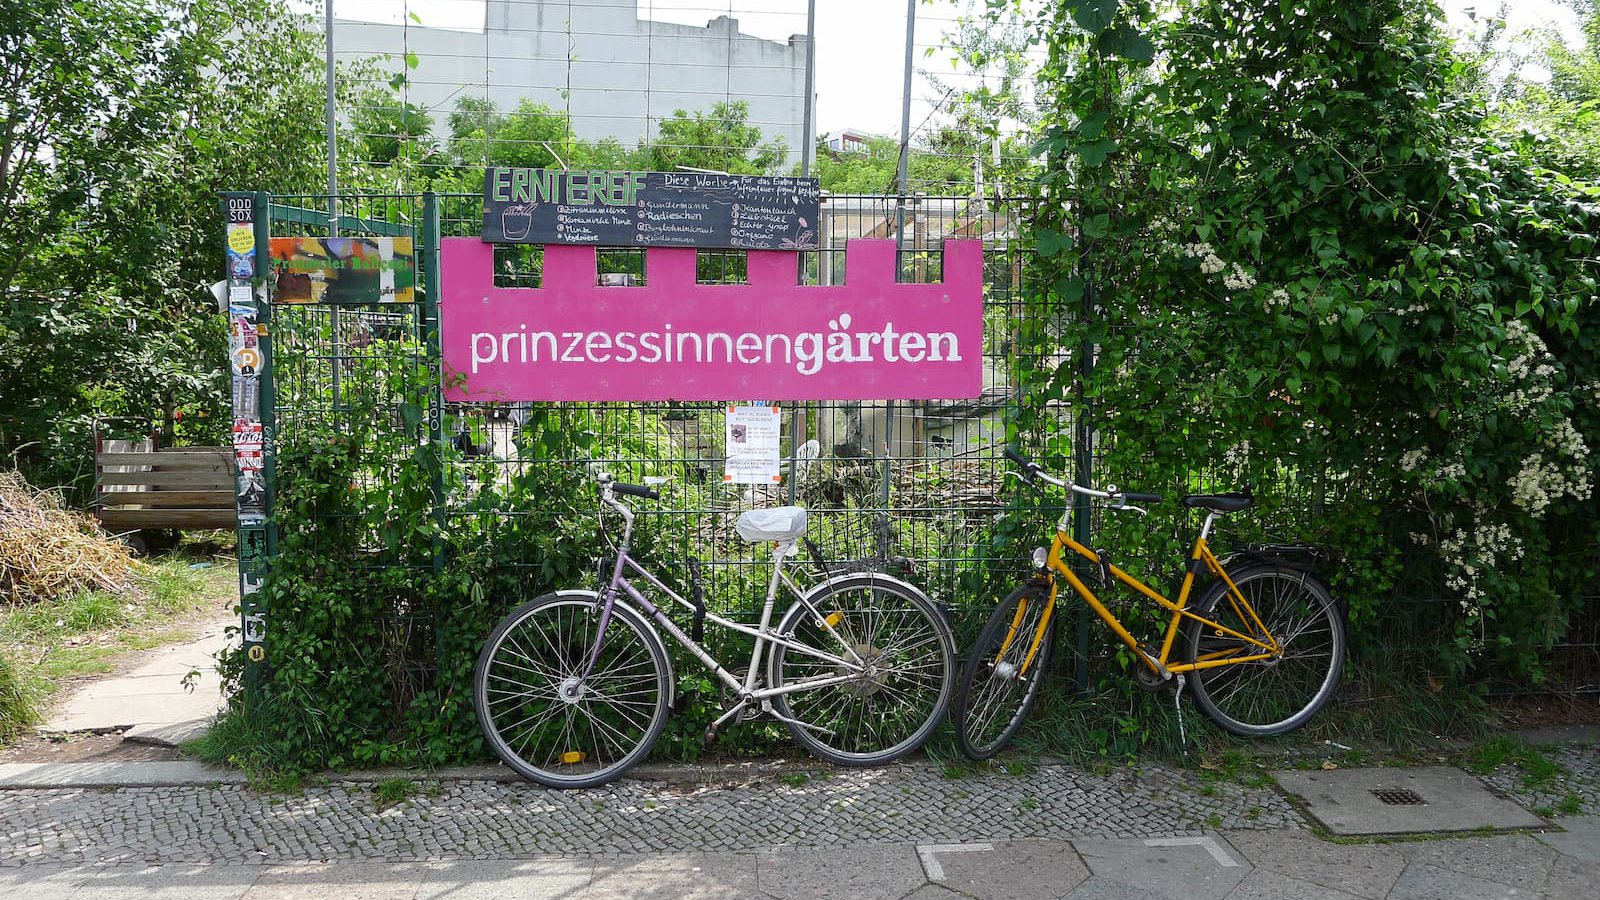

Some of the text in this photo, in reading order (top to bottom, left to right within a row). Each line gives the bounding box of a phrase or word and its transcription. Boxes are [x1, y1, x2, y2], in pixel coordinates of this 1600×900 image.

[664, 173, 728, 187] Diese Woche
[757, 177, 771, 186] das
[229, 199, 251, 209] ODD
[230, 211, 252, 222] SOX
[646, 209, 702, 220] Radieschen
[470, 312, 962, 376] prinzessinnengärten
